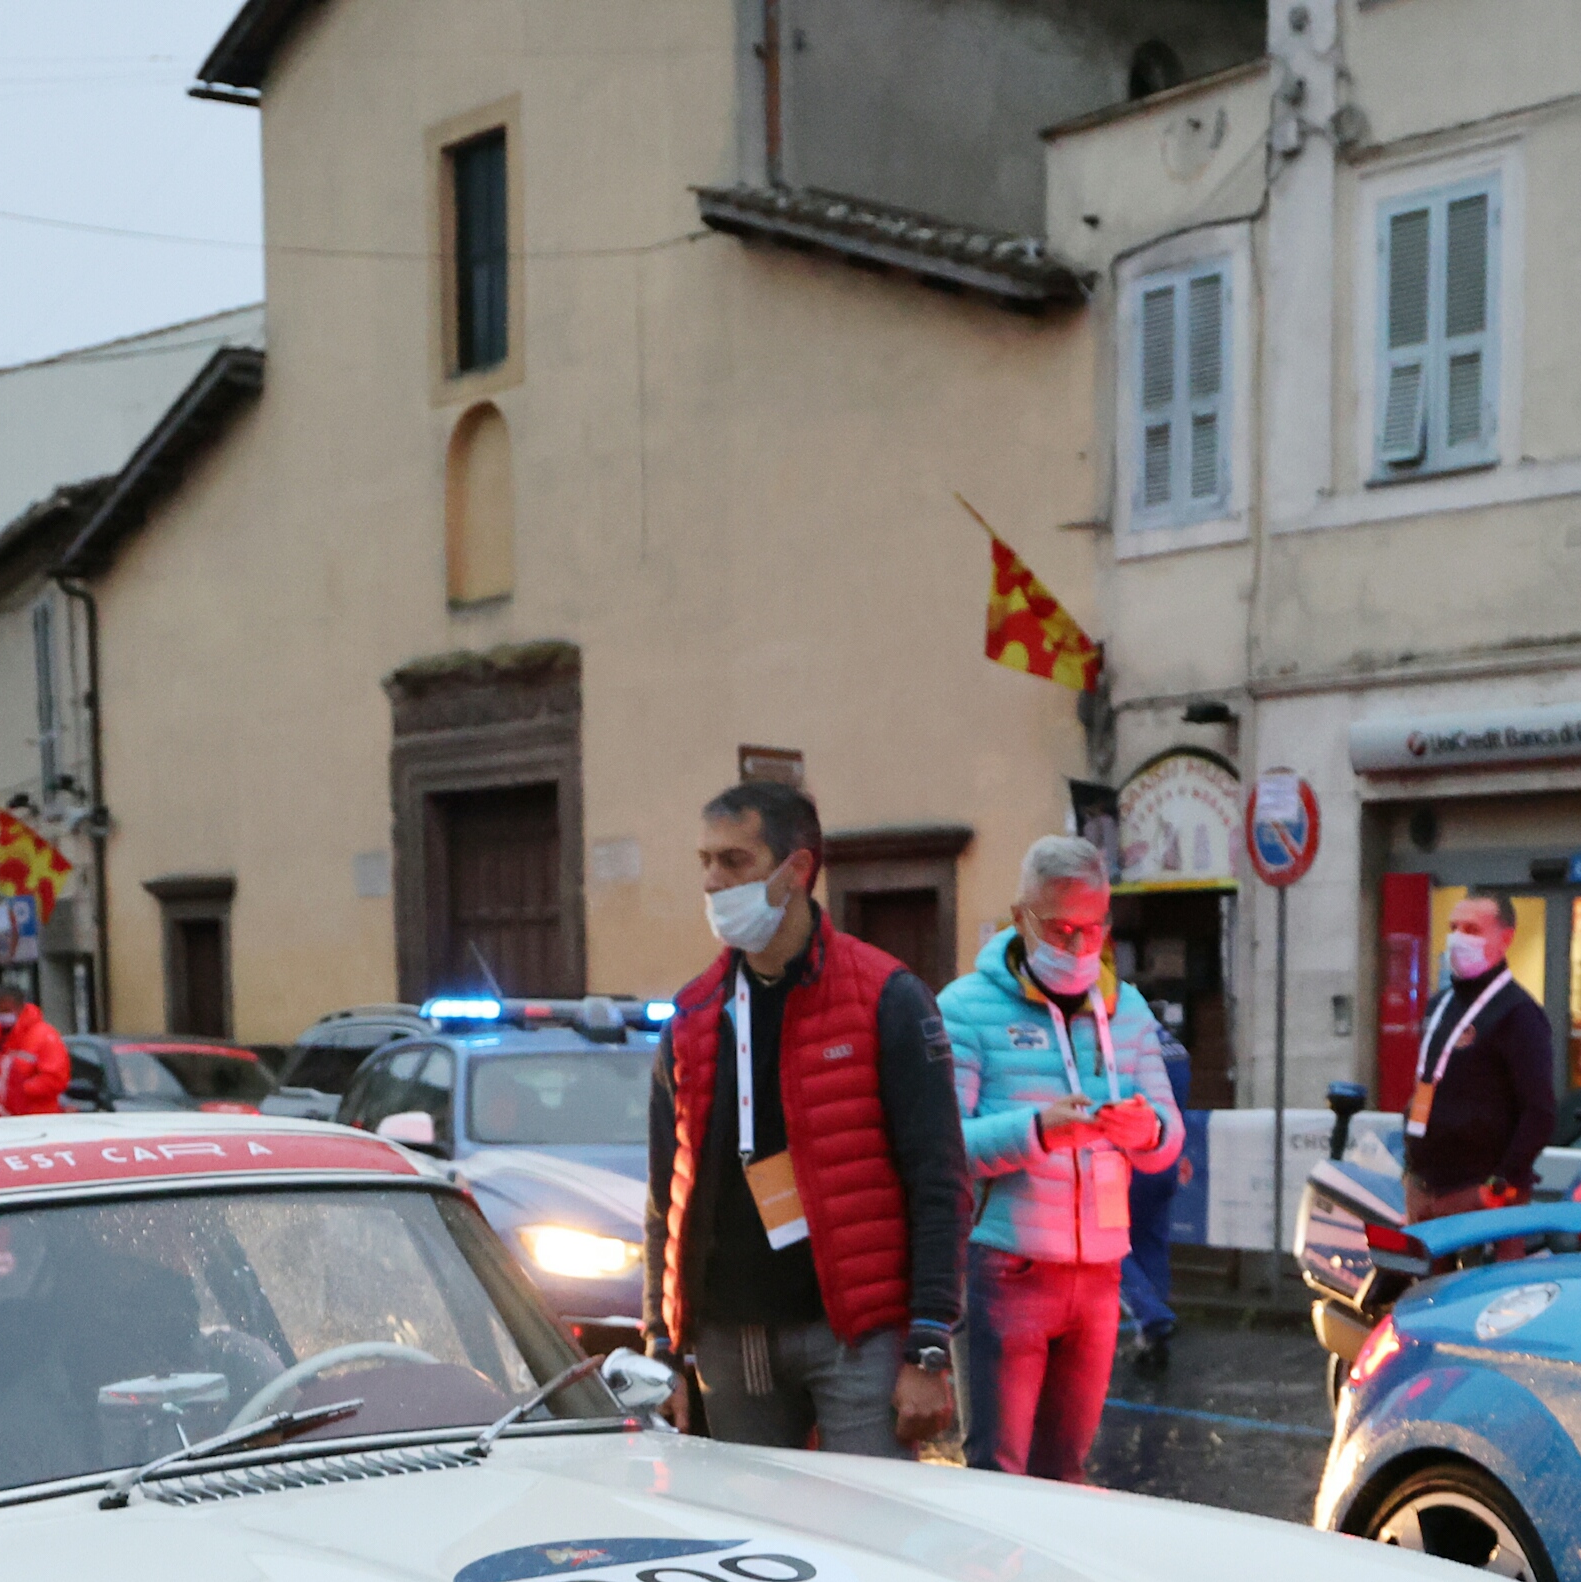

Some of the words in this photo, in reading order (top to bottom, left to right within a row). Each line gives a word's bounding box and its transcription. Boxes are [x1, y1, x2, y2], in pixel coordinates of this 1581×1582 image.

[1429, 727, 1502, 754] UniCredit
[1505, 725, 1559, 748] Banca
[1561, 721, 1576, 743] di
[100, 1141, 227, 1164] CAR
[246, 1140, 273, 1157] A
